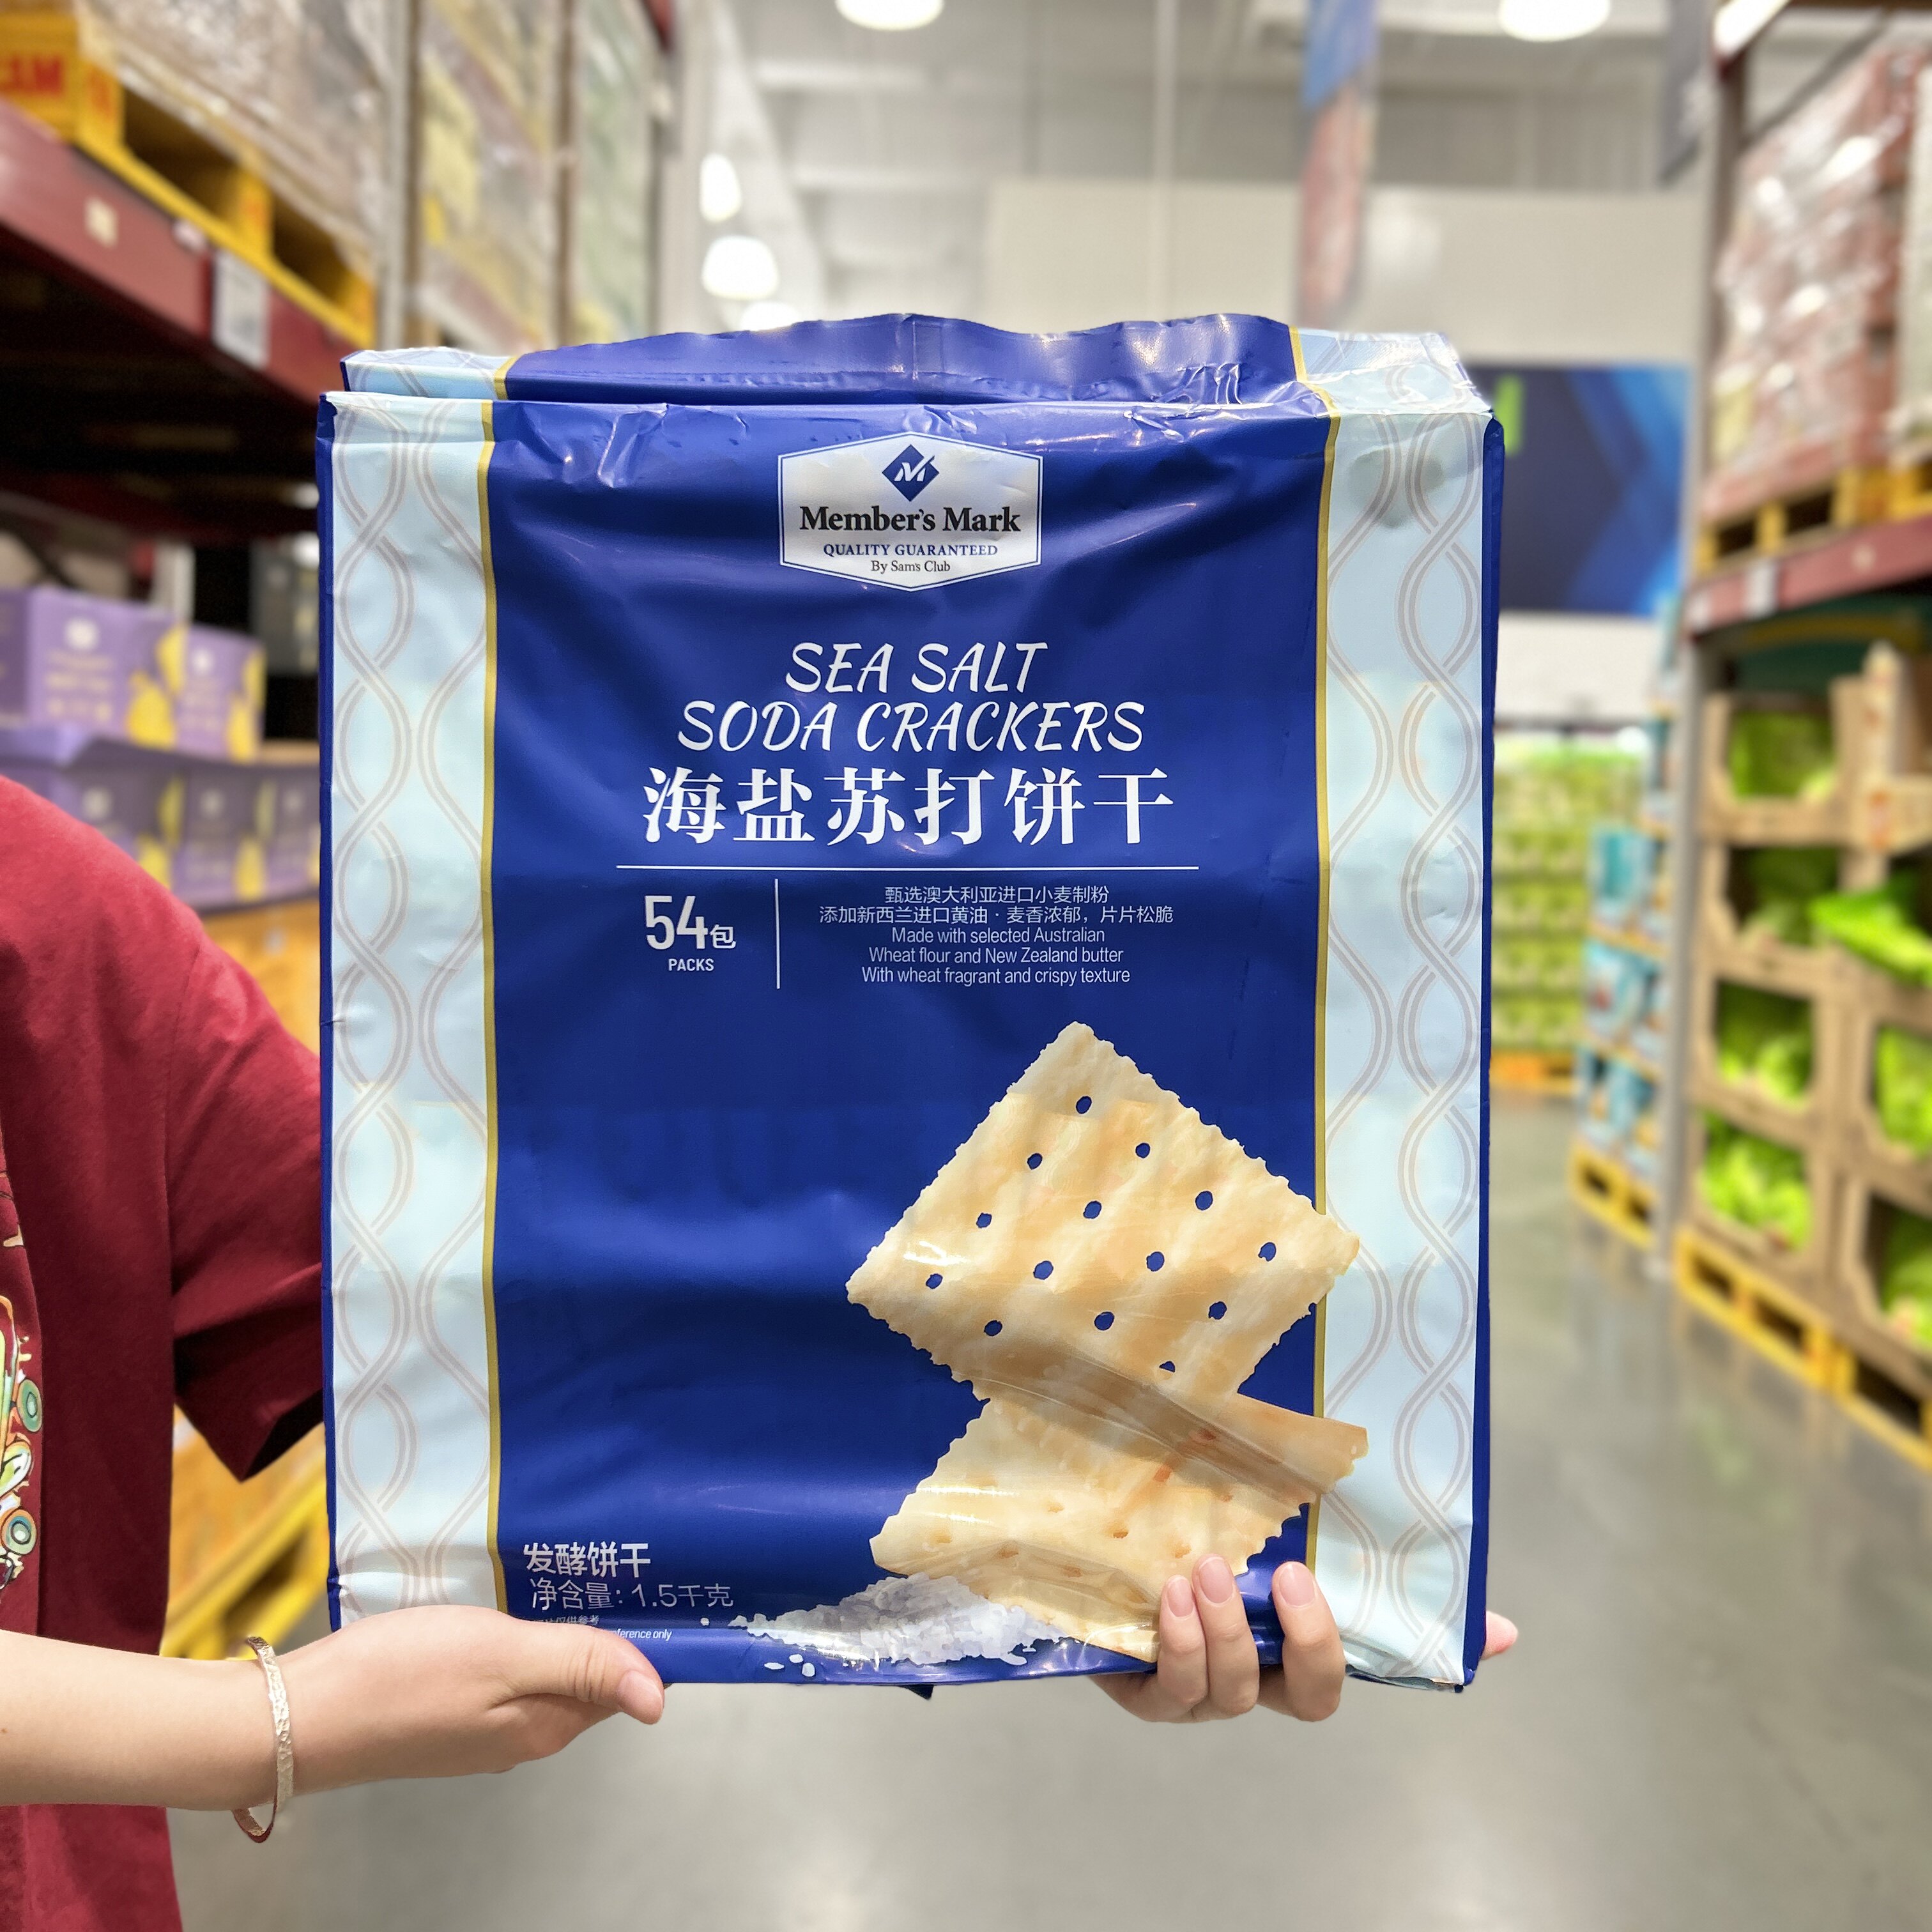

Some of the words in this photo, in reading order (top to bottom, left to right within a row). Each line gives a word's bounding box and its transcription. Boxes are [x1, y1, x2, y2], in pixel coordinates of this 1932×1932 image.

[799, 505, 936, 532] Member's
[942, 505, 1022, 532] Mark
[824, 543, 891, 557] QUALITY
[894, 544, 998, 556] GUARANTEED
[871, 560, 887, 574] By
[891, 560, 921, 572] Sam's
[924, 560, 951, 572] Club
[785, 642, 894, 693] SEA
[911, 641, 1048, 693] SALT
[677, 700, 838, 752] SODA
[857, 701, 1145, 753] CRACKERS
[642, 767, 1174, 845] 海盐苏打饼干
[884, 885, 1110, 904] 甄选澳大利亚进口小麦制粉
[892, 926, 934, 943] Made
[937, 926, 966, 943] with
[970, 926, 1030, 944] selected
[1033, 926, 1105, 943] Australian
[868, 946, 916, 963] Wheat
[919, 946, 951, 963] flour
[954, 947, 981, 964] and
[985, 947, 1018, 964] New
[1020, 946, 1078, 963] Zealand
[1082, 946, 1124, 963] butter
[668, 958, 714, 972] PACKS
[861, 966, 894, 983] With
[897, 966, 941, 983] wheat
[944, 966, 1001, 987] fragrant
[1004, 967, 1031, 984] and
[1034, 966, 1077, 987] crispy
[1080, 967, 1130, 983] texture
[523, 1540, 651, 1578] 发酵饼干
[652, 1629, 673, 1642] only
